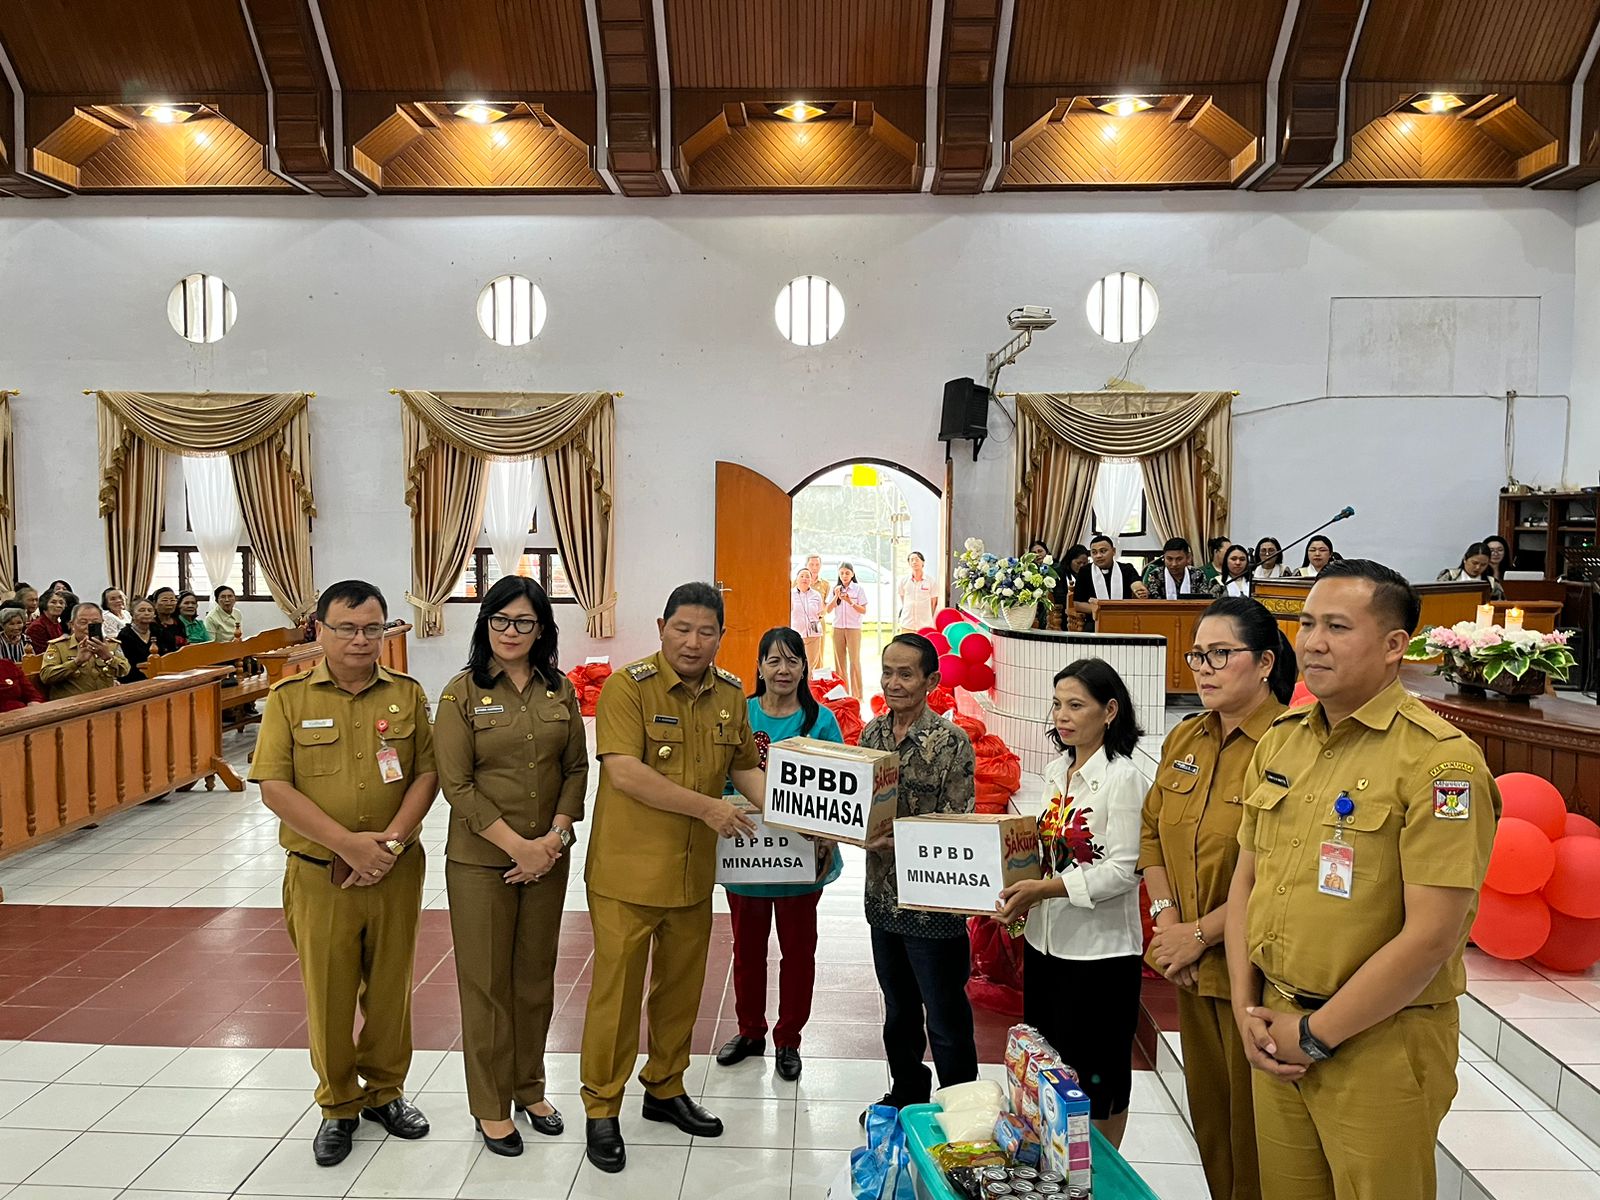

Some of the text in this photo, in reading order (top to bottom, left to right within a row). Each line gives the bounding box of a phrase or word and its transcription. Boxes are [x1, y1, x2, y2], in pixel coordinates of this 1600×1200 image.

[780, 760, 858, 796] BPBD
[771, 787, 864, 828] MINAHASA
[722, 856, 804, 869] MINAHASA
[907, 869, 991, 888] MINAHASA
